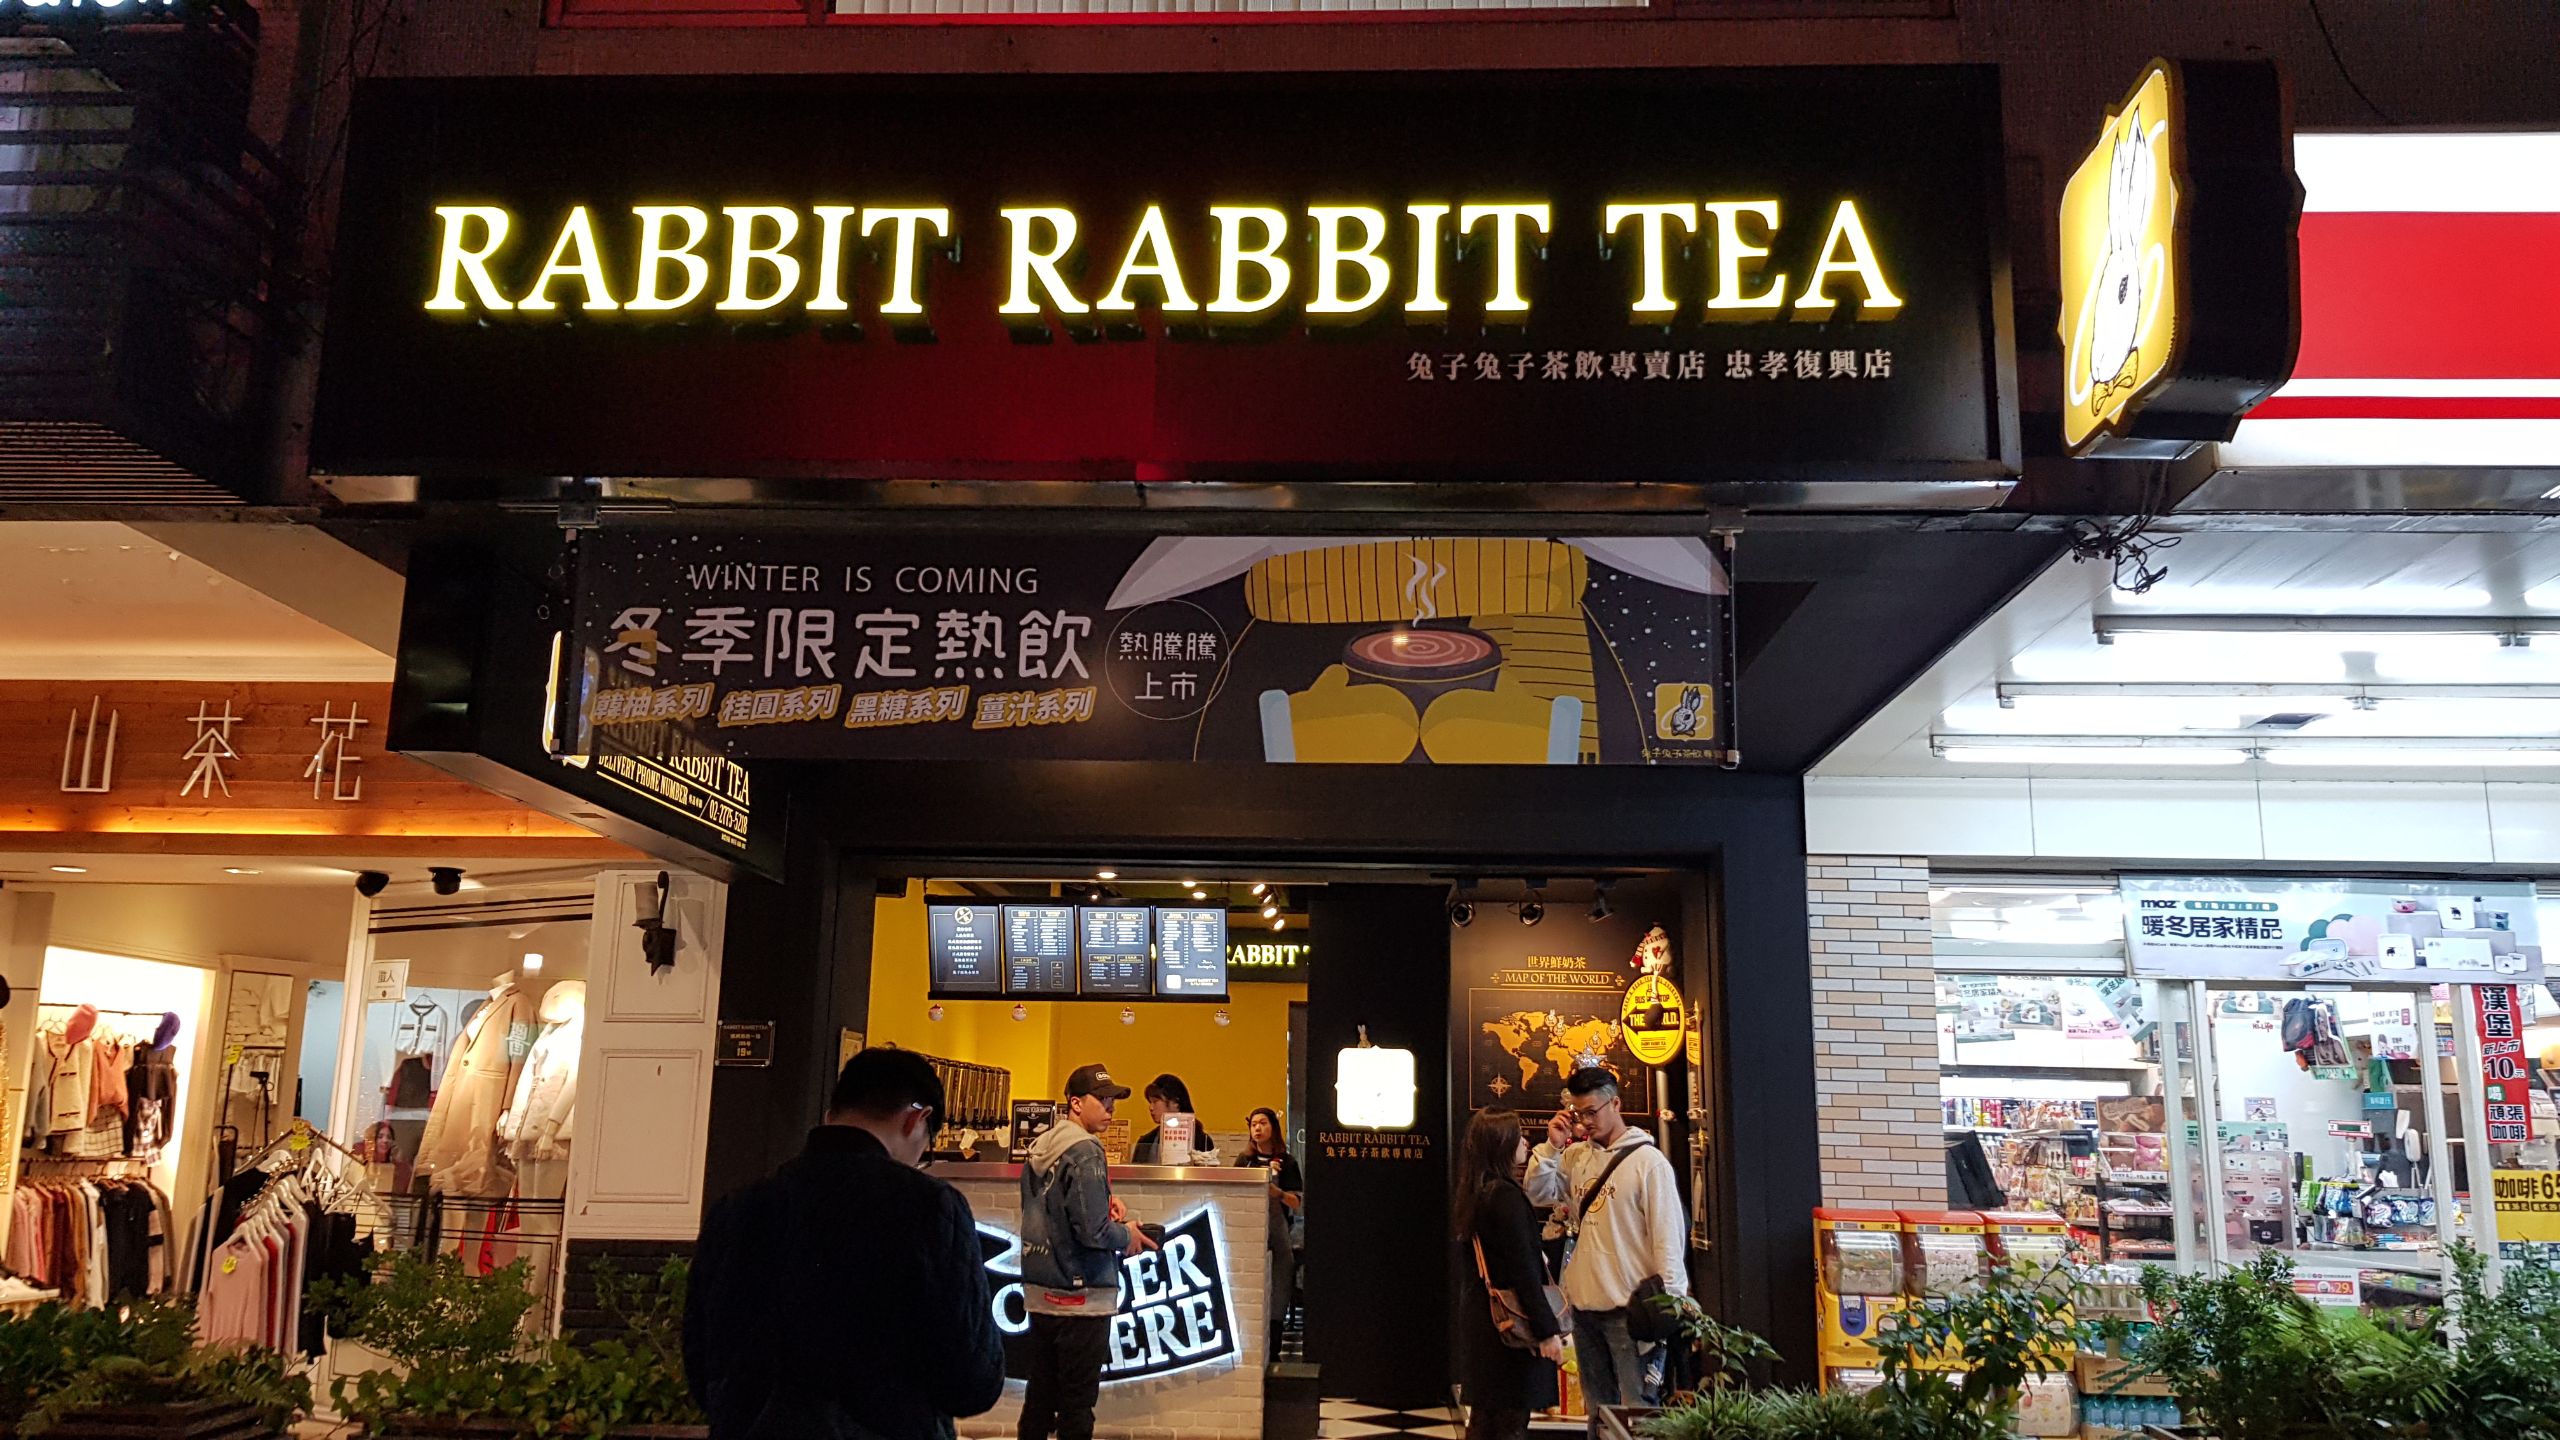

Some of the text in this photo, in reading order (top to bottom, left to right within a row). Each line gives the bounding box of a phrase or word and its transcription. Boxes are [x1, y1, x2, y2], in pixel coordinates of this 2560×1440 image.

[424, 199, 1903, 314] RABBIT RABBIT TEA
[1406, 348, 1893, 382] 兔子兔子茶飲專賣店 忠孝復興店
[689, 564, 1039, 594] WINTER IS COMING
[603, 607, 1091, 679] 冬季限定熱飲
[1119, 632, 1217, 661] 熱騰騰
[1134, 671, 1198, 701] 上市
[595, 685, 1093, 724] 韓柚系列 桂圓系列 黑糖系列 薑汁系列
[61, 695, 369, 801] 山茶花
[636, 764, 662, 795] PHONE
[659, 774, 689, 806] NUMBER
[726, 760, 750, 806] TEA
[2140, 900, 2178, 909] moz
[2141, 915, 2283, 940] 暖冬居家精品
[1505, 973, 1609, 985] MAP OF THE WORLD
[1629, 1013, 1646, 1026] THE
[2480, 986, 2514, 1037] 漢堡
[2482, 1040, 2521, 1056] 新上市
[1319, 1131, 1431, 1146] RABBIT RABBIT TEA
[1104, 1290, 1222, 1373] ERE
